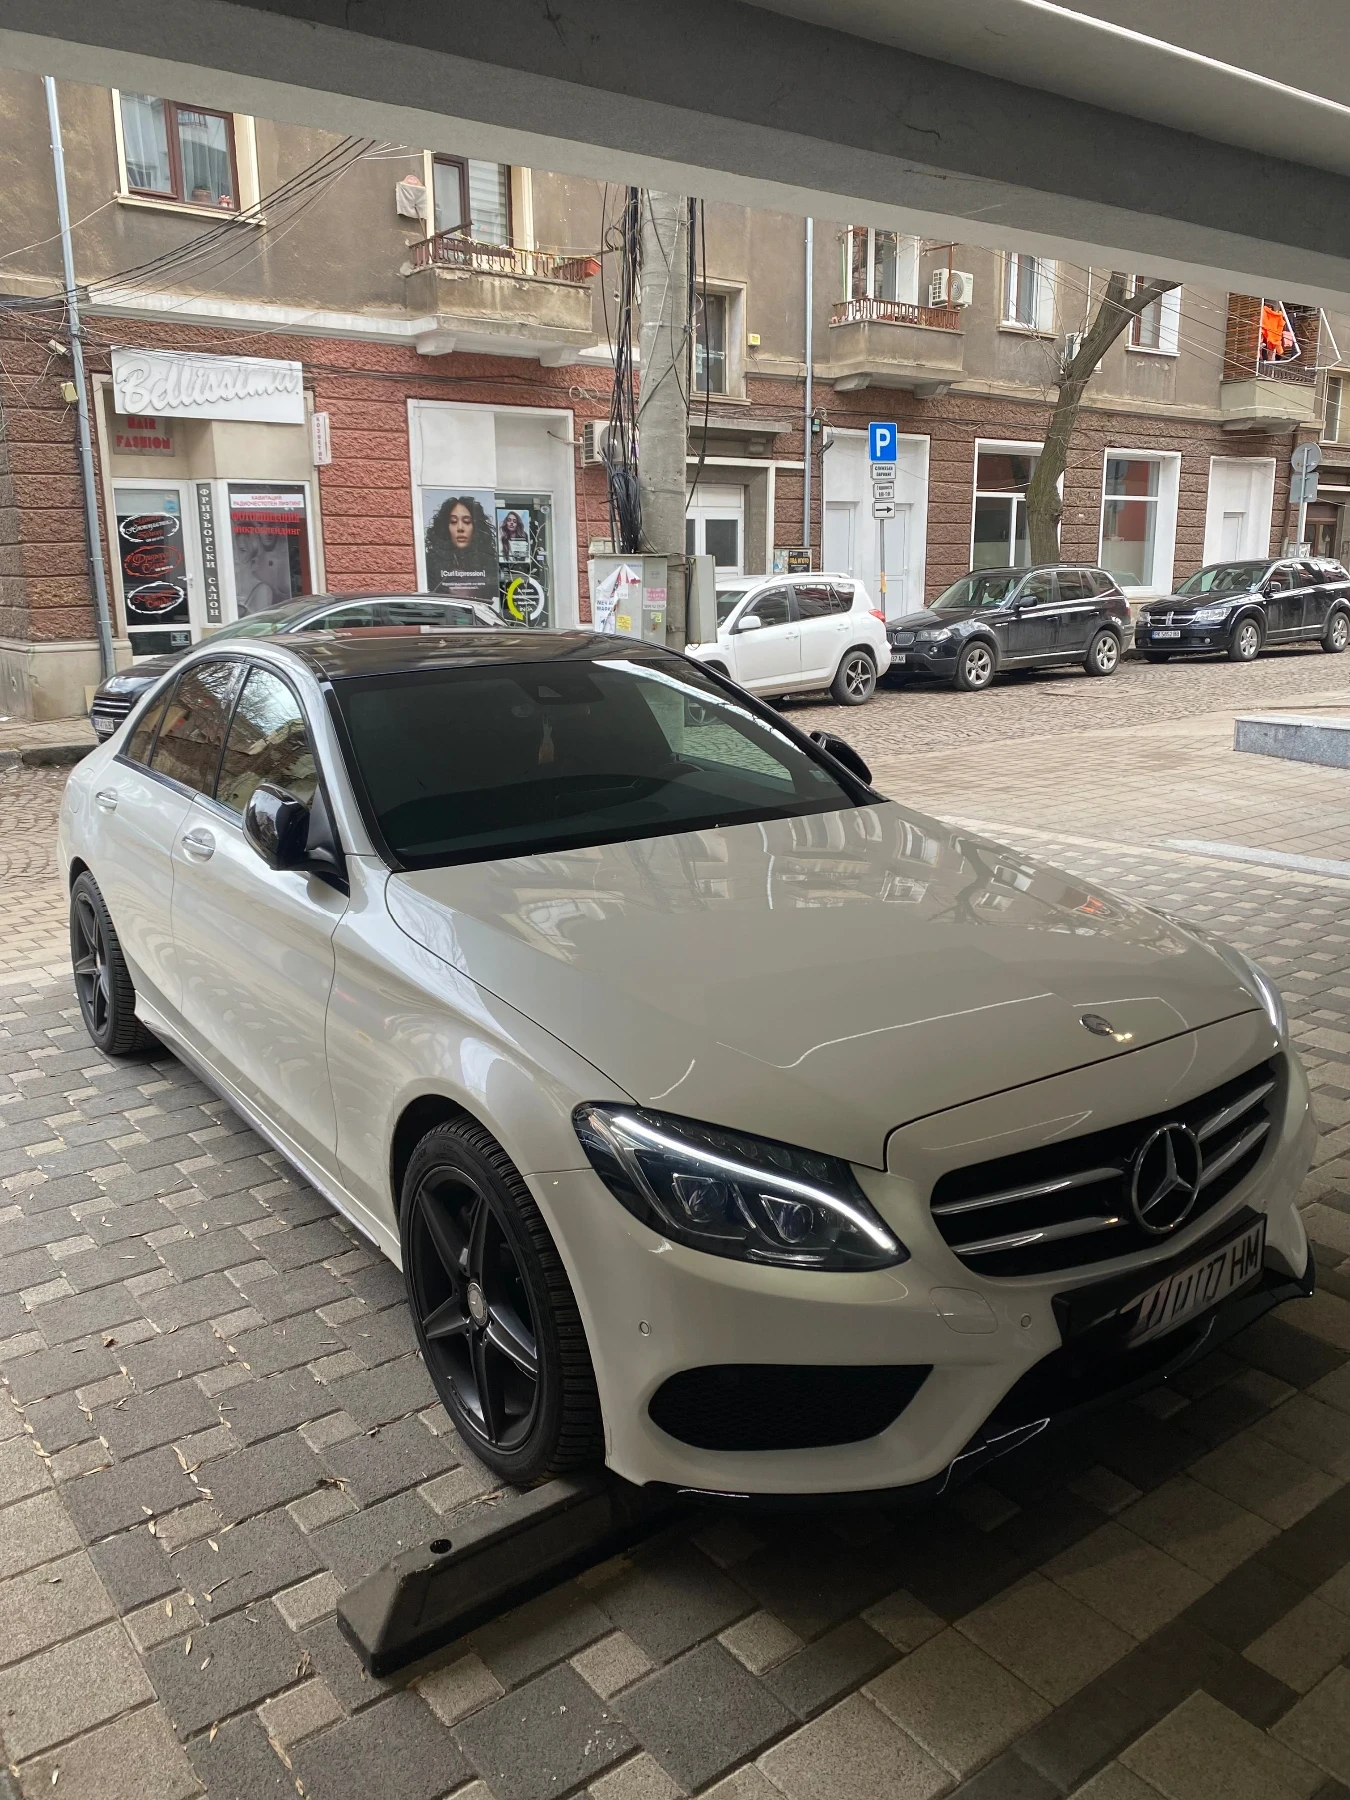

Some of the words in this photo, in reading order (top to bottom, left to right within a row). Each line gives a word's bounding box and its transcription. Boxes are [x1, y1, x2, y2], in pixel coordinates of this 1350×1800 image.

[127, 416, 156, 429] HAIR
[116, 434, 171, 449] FASHION
[876, 428, 890, 457] P
[199, 488, 216, 568] ФРИЗЬОРСКИ
[208, 577, 220, 616] САЛОН
